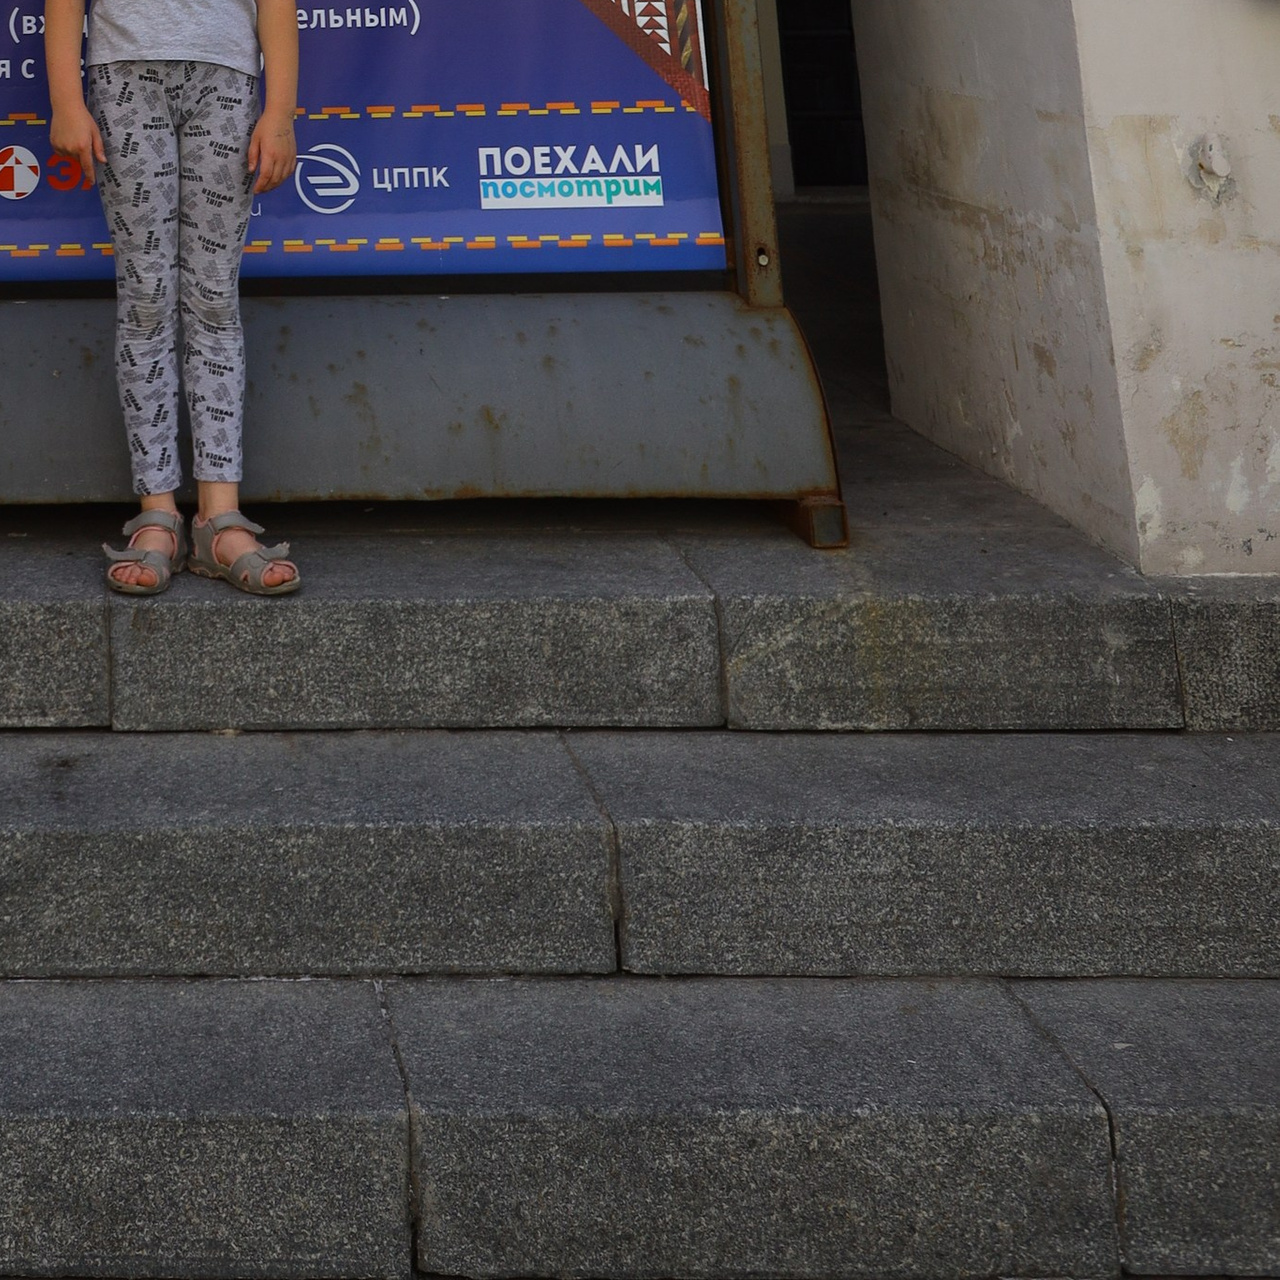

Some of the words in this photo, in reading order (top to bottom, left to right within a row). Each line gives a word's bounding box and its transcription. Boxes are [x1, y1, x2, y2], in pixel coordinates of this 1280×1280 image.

[21, 58, 35, 79] с
[478, 144, 660, 175] ПОЕХАЛИ
[372, 166, 449, 192] ЦППК
[481, 178, 662, 204] посмотрим
